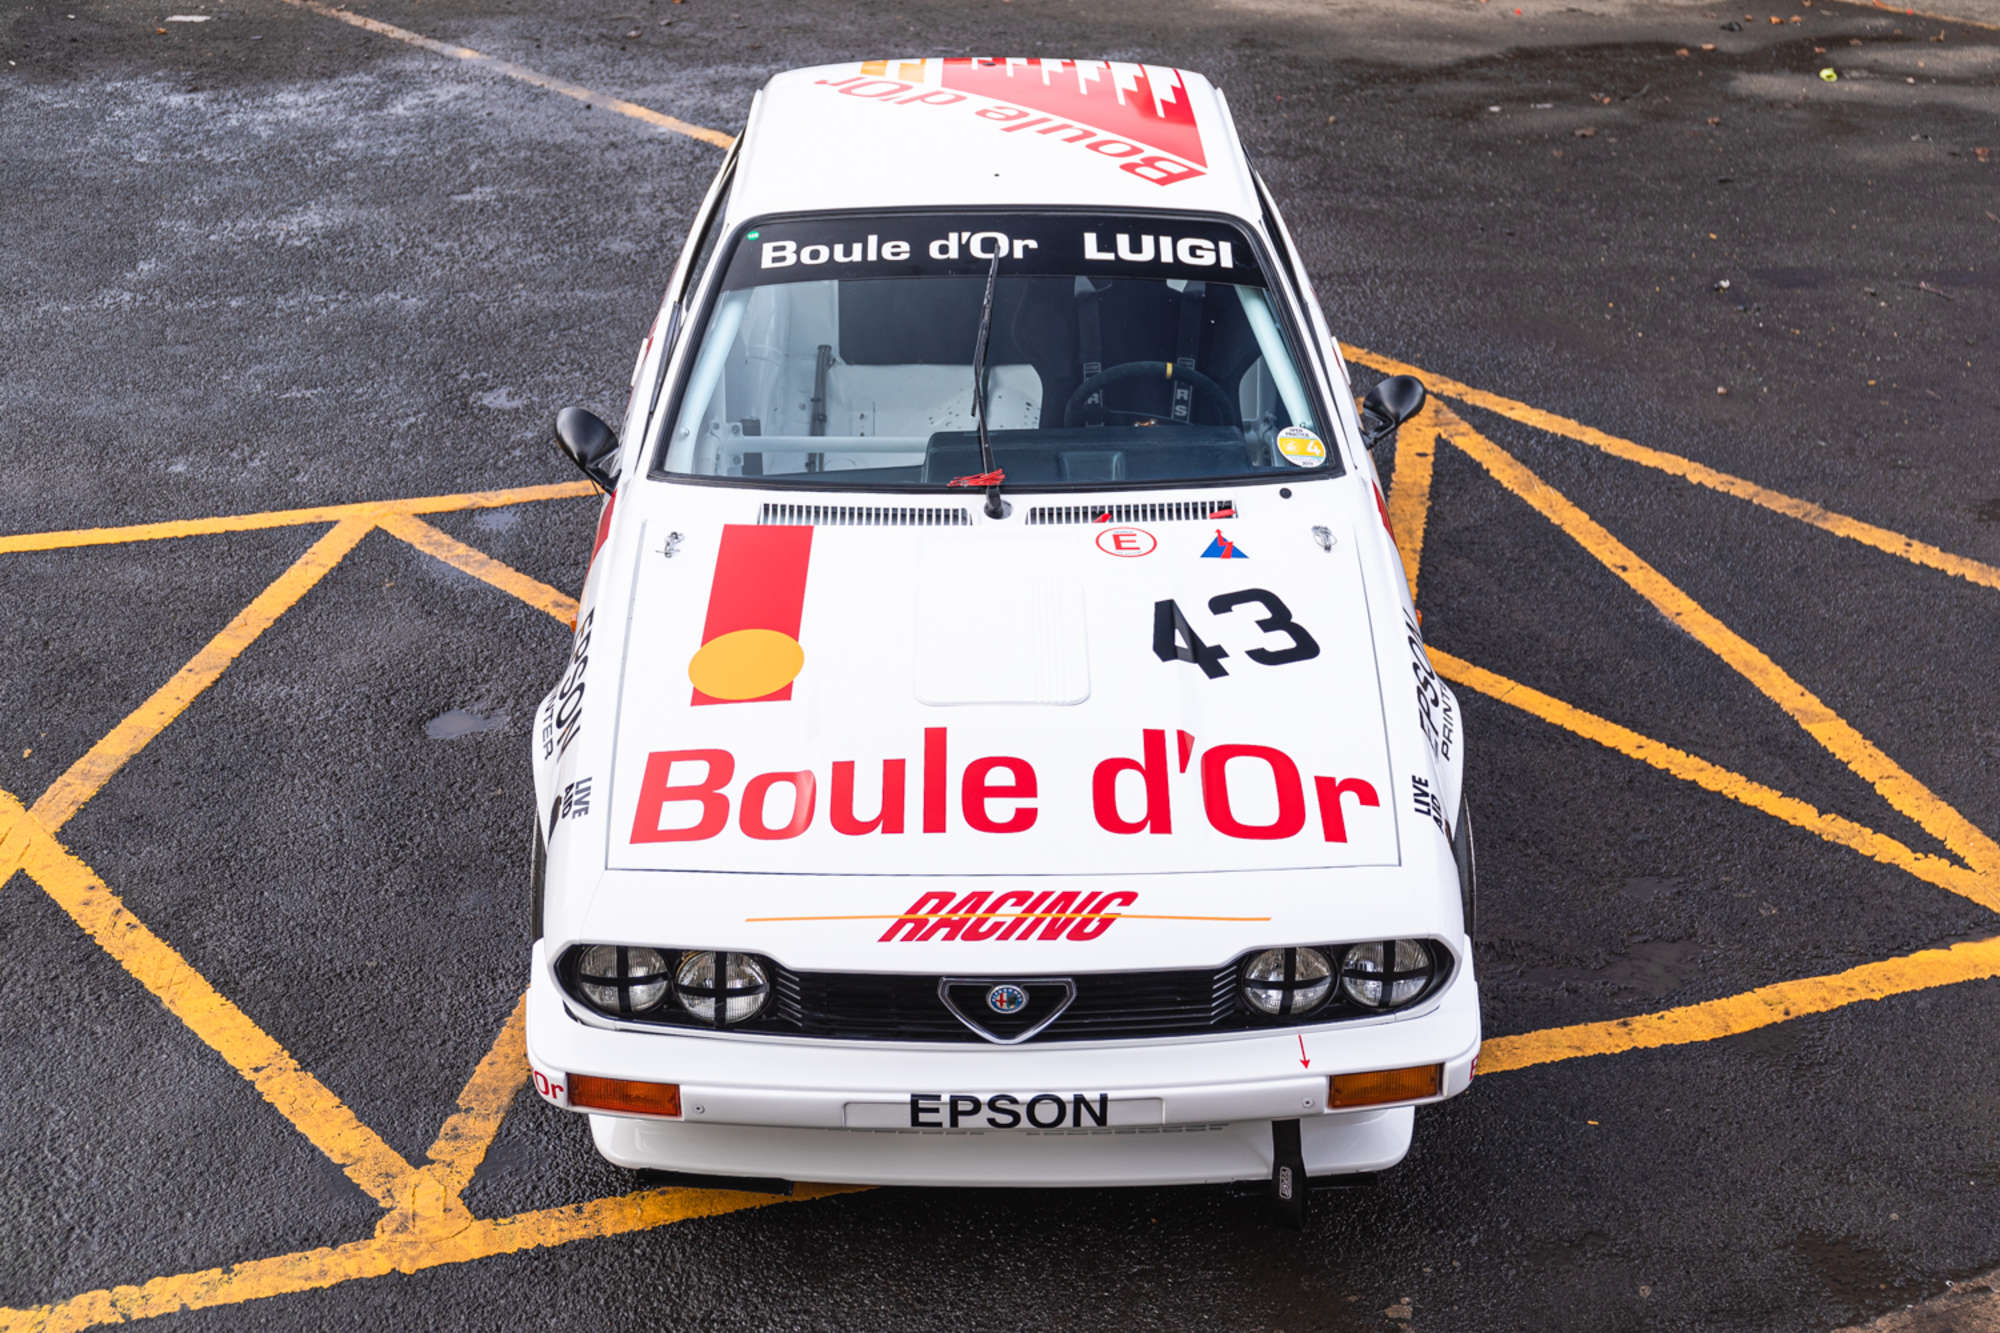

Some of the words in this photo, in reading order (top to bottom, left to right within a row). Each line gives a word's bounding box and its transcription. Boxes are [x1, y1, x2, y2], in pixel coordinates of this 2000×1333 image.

[813, 76, 967, 105] d'Or
[975, 105, 1207, 186] Boule
[760, 233, 910, 268] Boule
[929, 231, 1038, 263] d'Or
[1084, 231, 1233, 268] LUIGI
[1112, 533, 1141, 551] E
[1153, 588, 1320, 679] 43
[561, 783, 574, 819] AID
[572, 776, 592, 819] LIVE
[629, 727, 1038, 844] Boule
[1092, 727, 1380, 844] d'Or
[1412, 774, 1432, 817] LIVE
[1430, 793, 1444, 834] AID
[878, 890, 1138, 942] RACING
[910, 1093, 1108, 1129] EPSON
